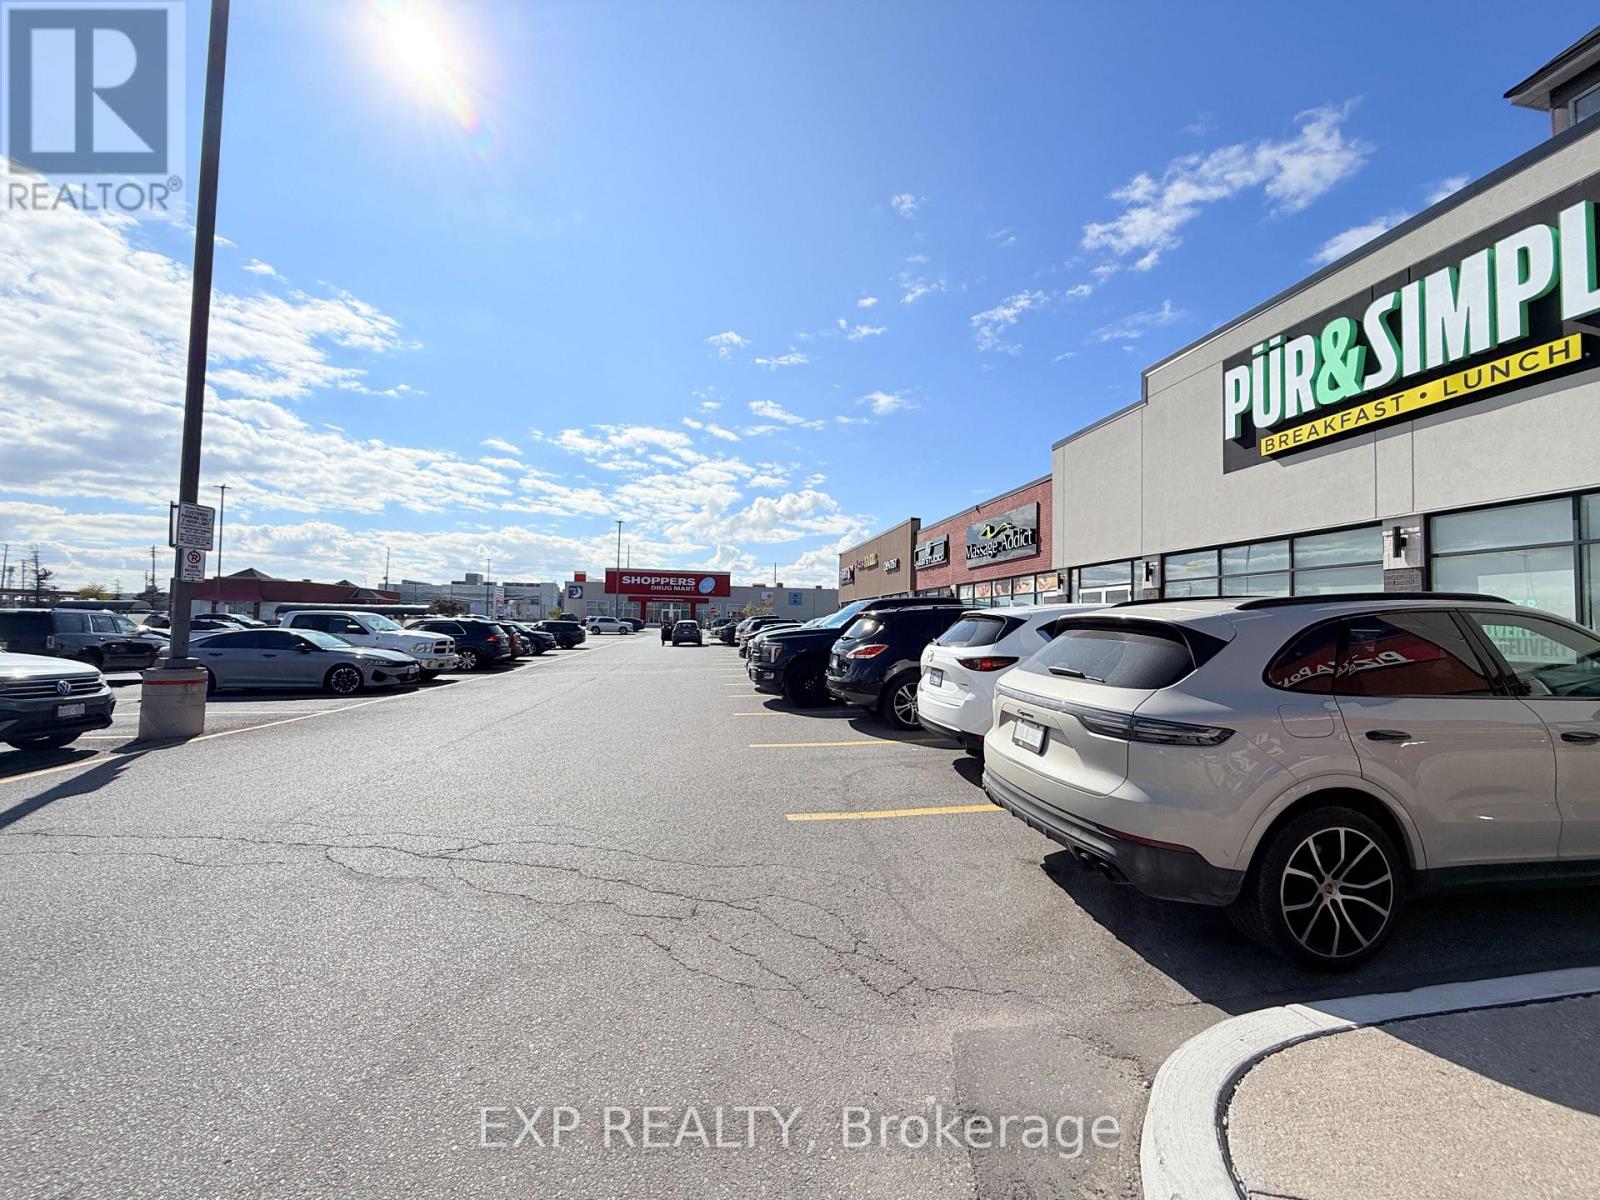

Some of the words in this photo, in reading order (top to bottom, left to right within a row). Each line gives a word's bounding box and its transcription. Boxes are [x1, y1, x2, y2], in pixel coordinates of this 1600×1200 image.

[1264, 396, 1405, 453] BREAKFAST
[1443, 339, 1571, 397] LUNCH
[966, 540, 998, 558] Massage
[1002, 528, 1032, 550] Addict
[925, 554, 943, 565] STUDIO
[622, 576, 696, 586] SHOPPERS
